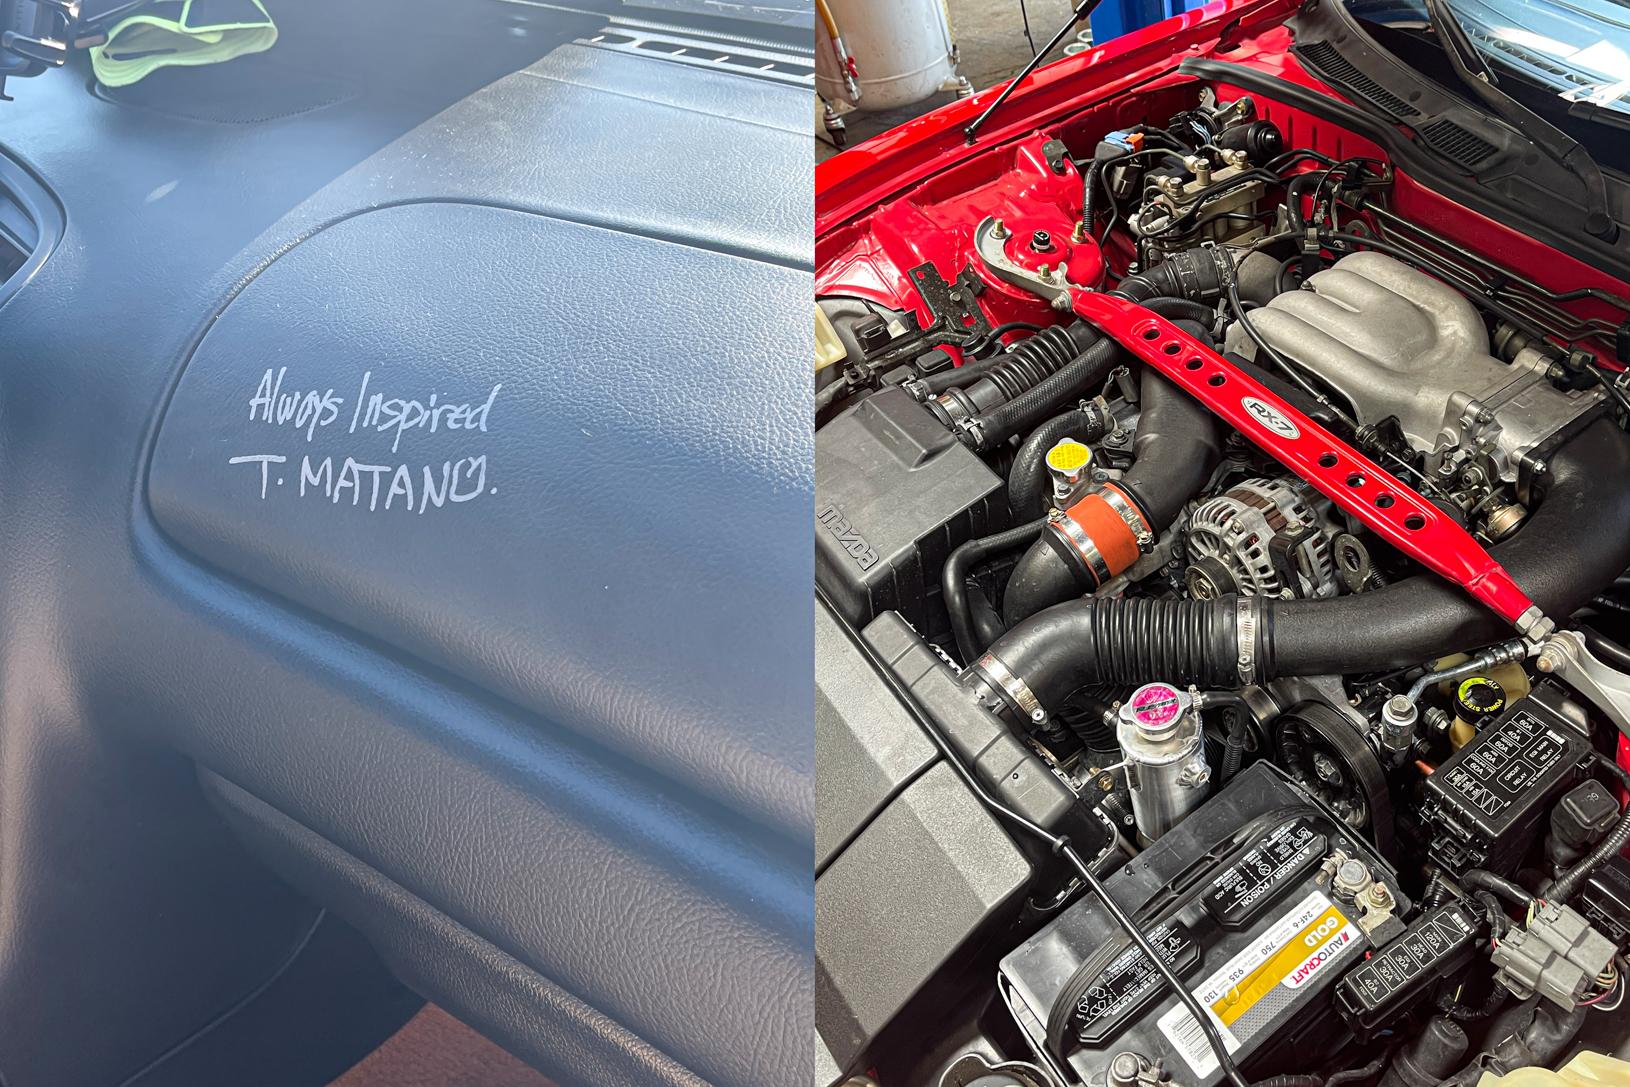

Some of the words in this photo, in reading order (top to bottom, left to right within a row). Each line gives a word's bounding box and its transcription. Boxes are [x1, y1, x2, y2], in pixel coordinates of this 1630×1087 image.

[250, 366, 344, 442] Always
[350, 371, 502, 453] Inspired
[1250, 402, 1293, 432] RX-7
[229, 455, 286, 499] T.
[817, 505, 880, 572] mazda
[1518, 718, 1533, 731] 60A
[1506, 728, 1521, 741] 40A
[1493, 739, 1509, 752] 60A
[1539, 747, 1554, 761] RELAY
[1481, 750, 1497, 763] 60A
[1468, 761, 1484, 775] 60A
[1512, 772, 1527, 786] RELAY
[1272, 852, 1305, 880] DANGER
[1239, 881, 1270, 907] POISON
[1291, 909, 1313, 929] 24F-6
[1301, 913, 1340, 948] GOLD
[1259, 940, 1276, 955] 750
[1423, 930, 1441, 950] 120A
[1409, 943, 1424, 960] 30A
[1290, 936, 1344, 985] AUTOCRAFT
[1394, 953, 1409, 970] 30A
[1227, 966, 1244, 982] 935
[1378, 965, 1394, 982] 30A
[1381, 957, 1402, 982] RETRACTOR
[1363, 976, 1379, 994] 40A
[1202, 988, 1218, 1003] 130
